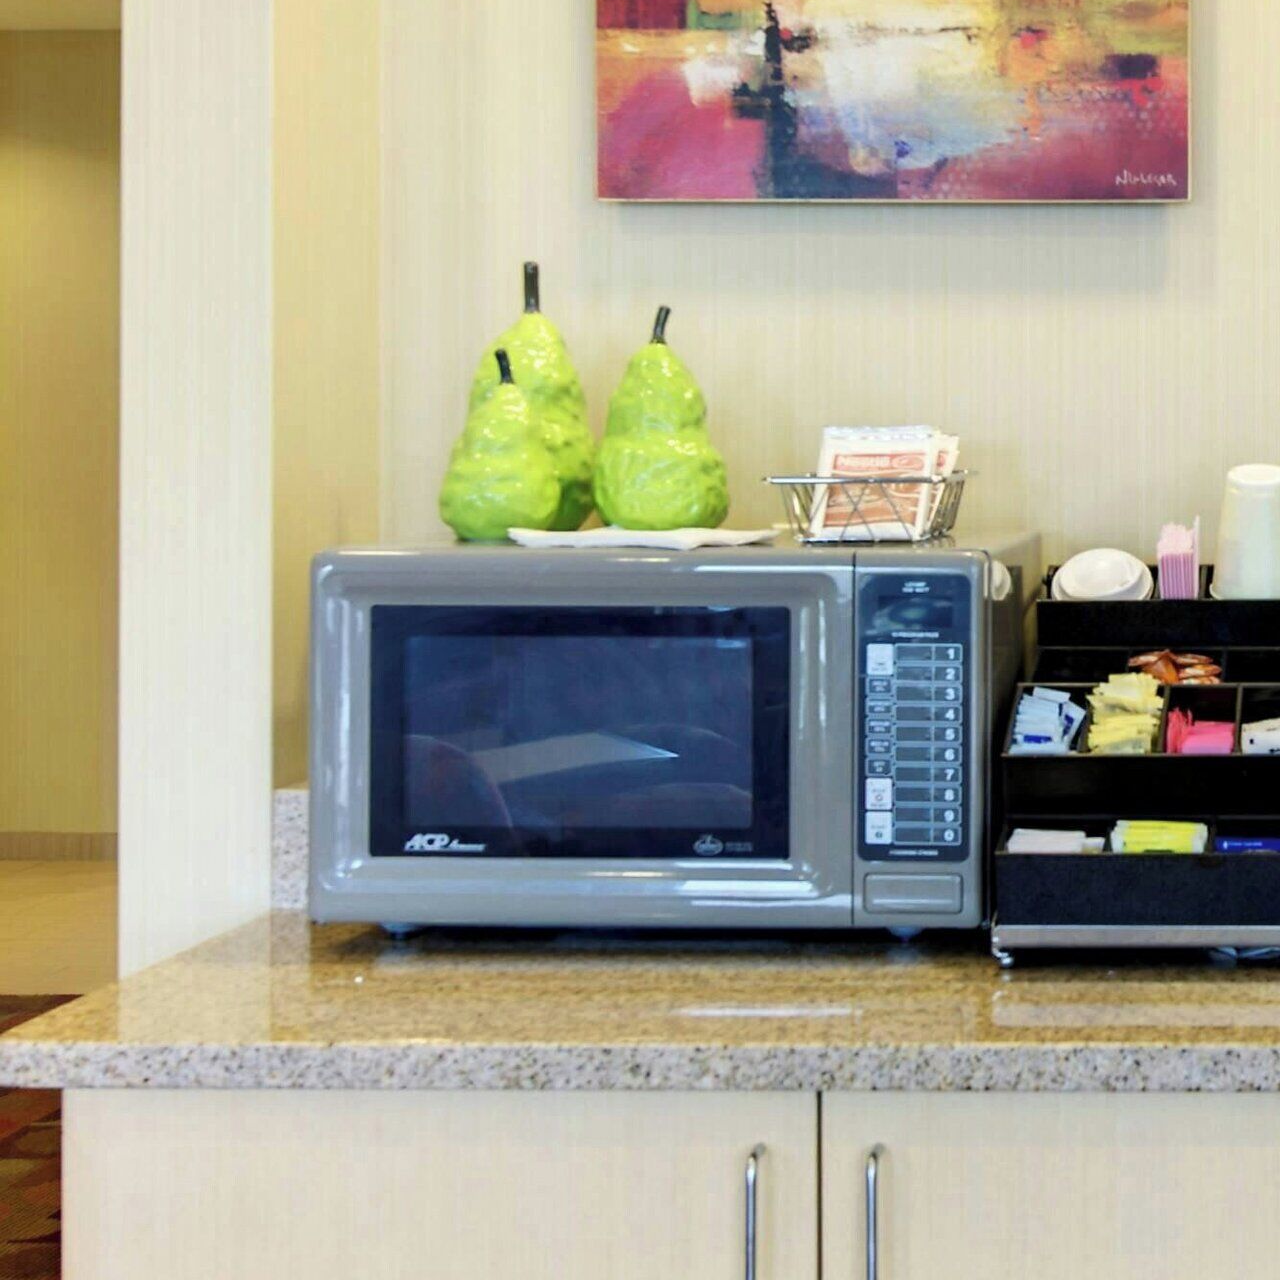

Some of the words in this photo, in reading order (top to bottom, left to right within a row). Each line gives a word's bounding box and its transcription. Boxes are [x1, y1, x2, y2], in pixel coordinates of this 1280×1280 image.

[947, 648, 955, 660] 1
[945, 668, 956, 680] 2
[945, 687, 956, 700] 3
[945, 708, 956, 720] 4
[945, 728, 956, 741] 5
[944, 748, 955, 761] 6
[944, 768, 955, 781] 7
[944, 789, 955, 801] 8
